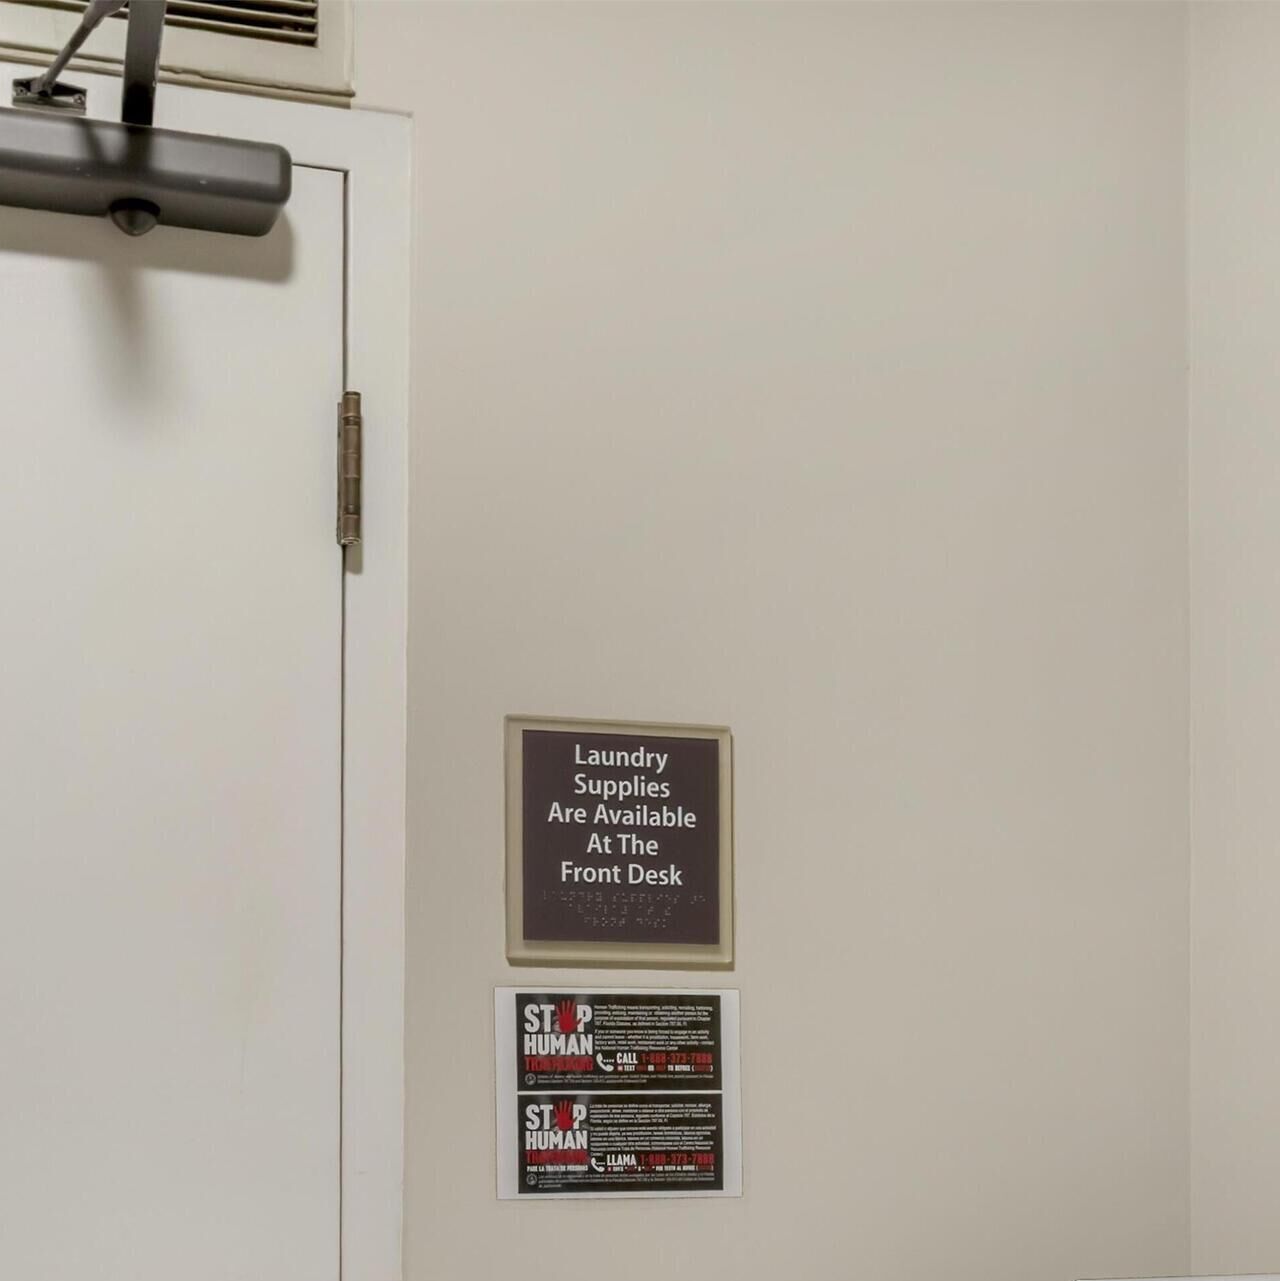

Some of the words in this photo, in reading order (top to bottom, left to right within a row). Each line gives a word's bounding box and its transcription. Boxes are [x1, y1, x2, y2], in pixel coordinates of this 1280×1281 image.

[574, 744, 668, 773] Laundry
[574, 773, 670, 801] Supplies
[547, 802, 587, 823] Are
[593, 803, 697, 828] Available
[586, 833, 612, 854] At
[617, 834, 659, 856] The
[561, 861, 621, 884] Front
[628, 863, 683, 886] Desk
[524, 1002, 593, 1033] STP
[524, 1034, 593, 1055] HUMAN
[616, 1052, 638, 1065] CALL
[525, 1104, 587, 1130] STP
[525, 1130, 588, 1150] HUMAN
[606, 1154, 637, 1166] LLAMA
